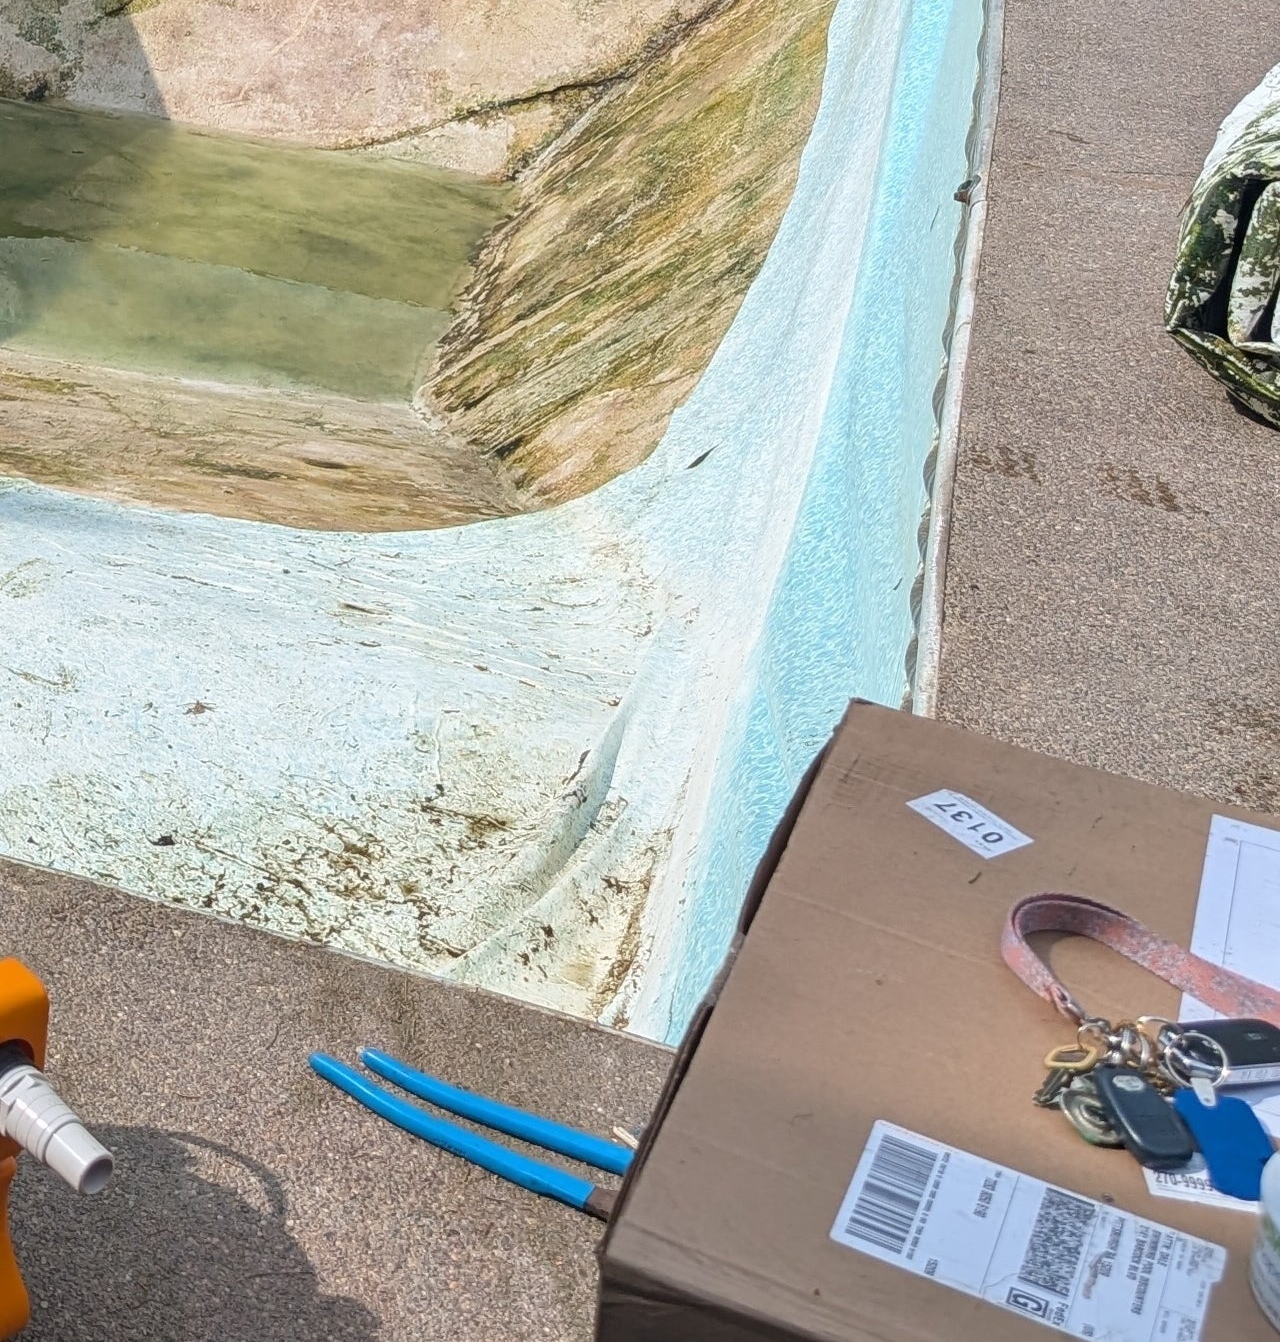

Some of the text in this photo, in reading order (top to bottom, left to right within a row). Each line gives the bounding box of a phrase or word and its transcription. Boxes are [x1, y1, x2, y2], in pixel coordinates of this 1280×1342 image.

[934, 802, 1003, 844] 0137
[1014, 1294, 1040, 1311] G
[1052, 1301, 1069, 1326] FedEx
